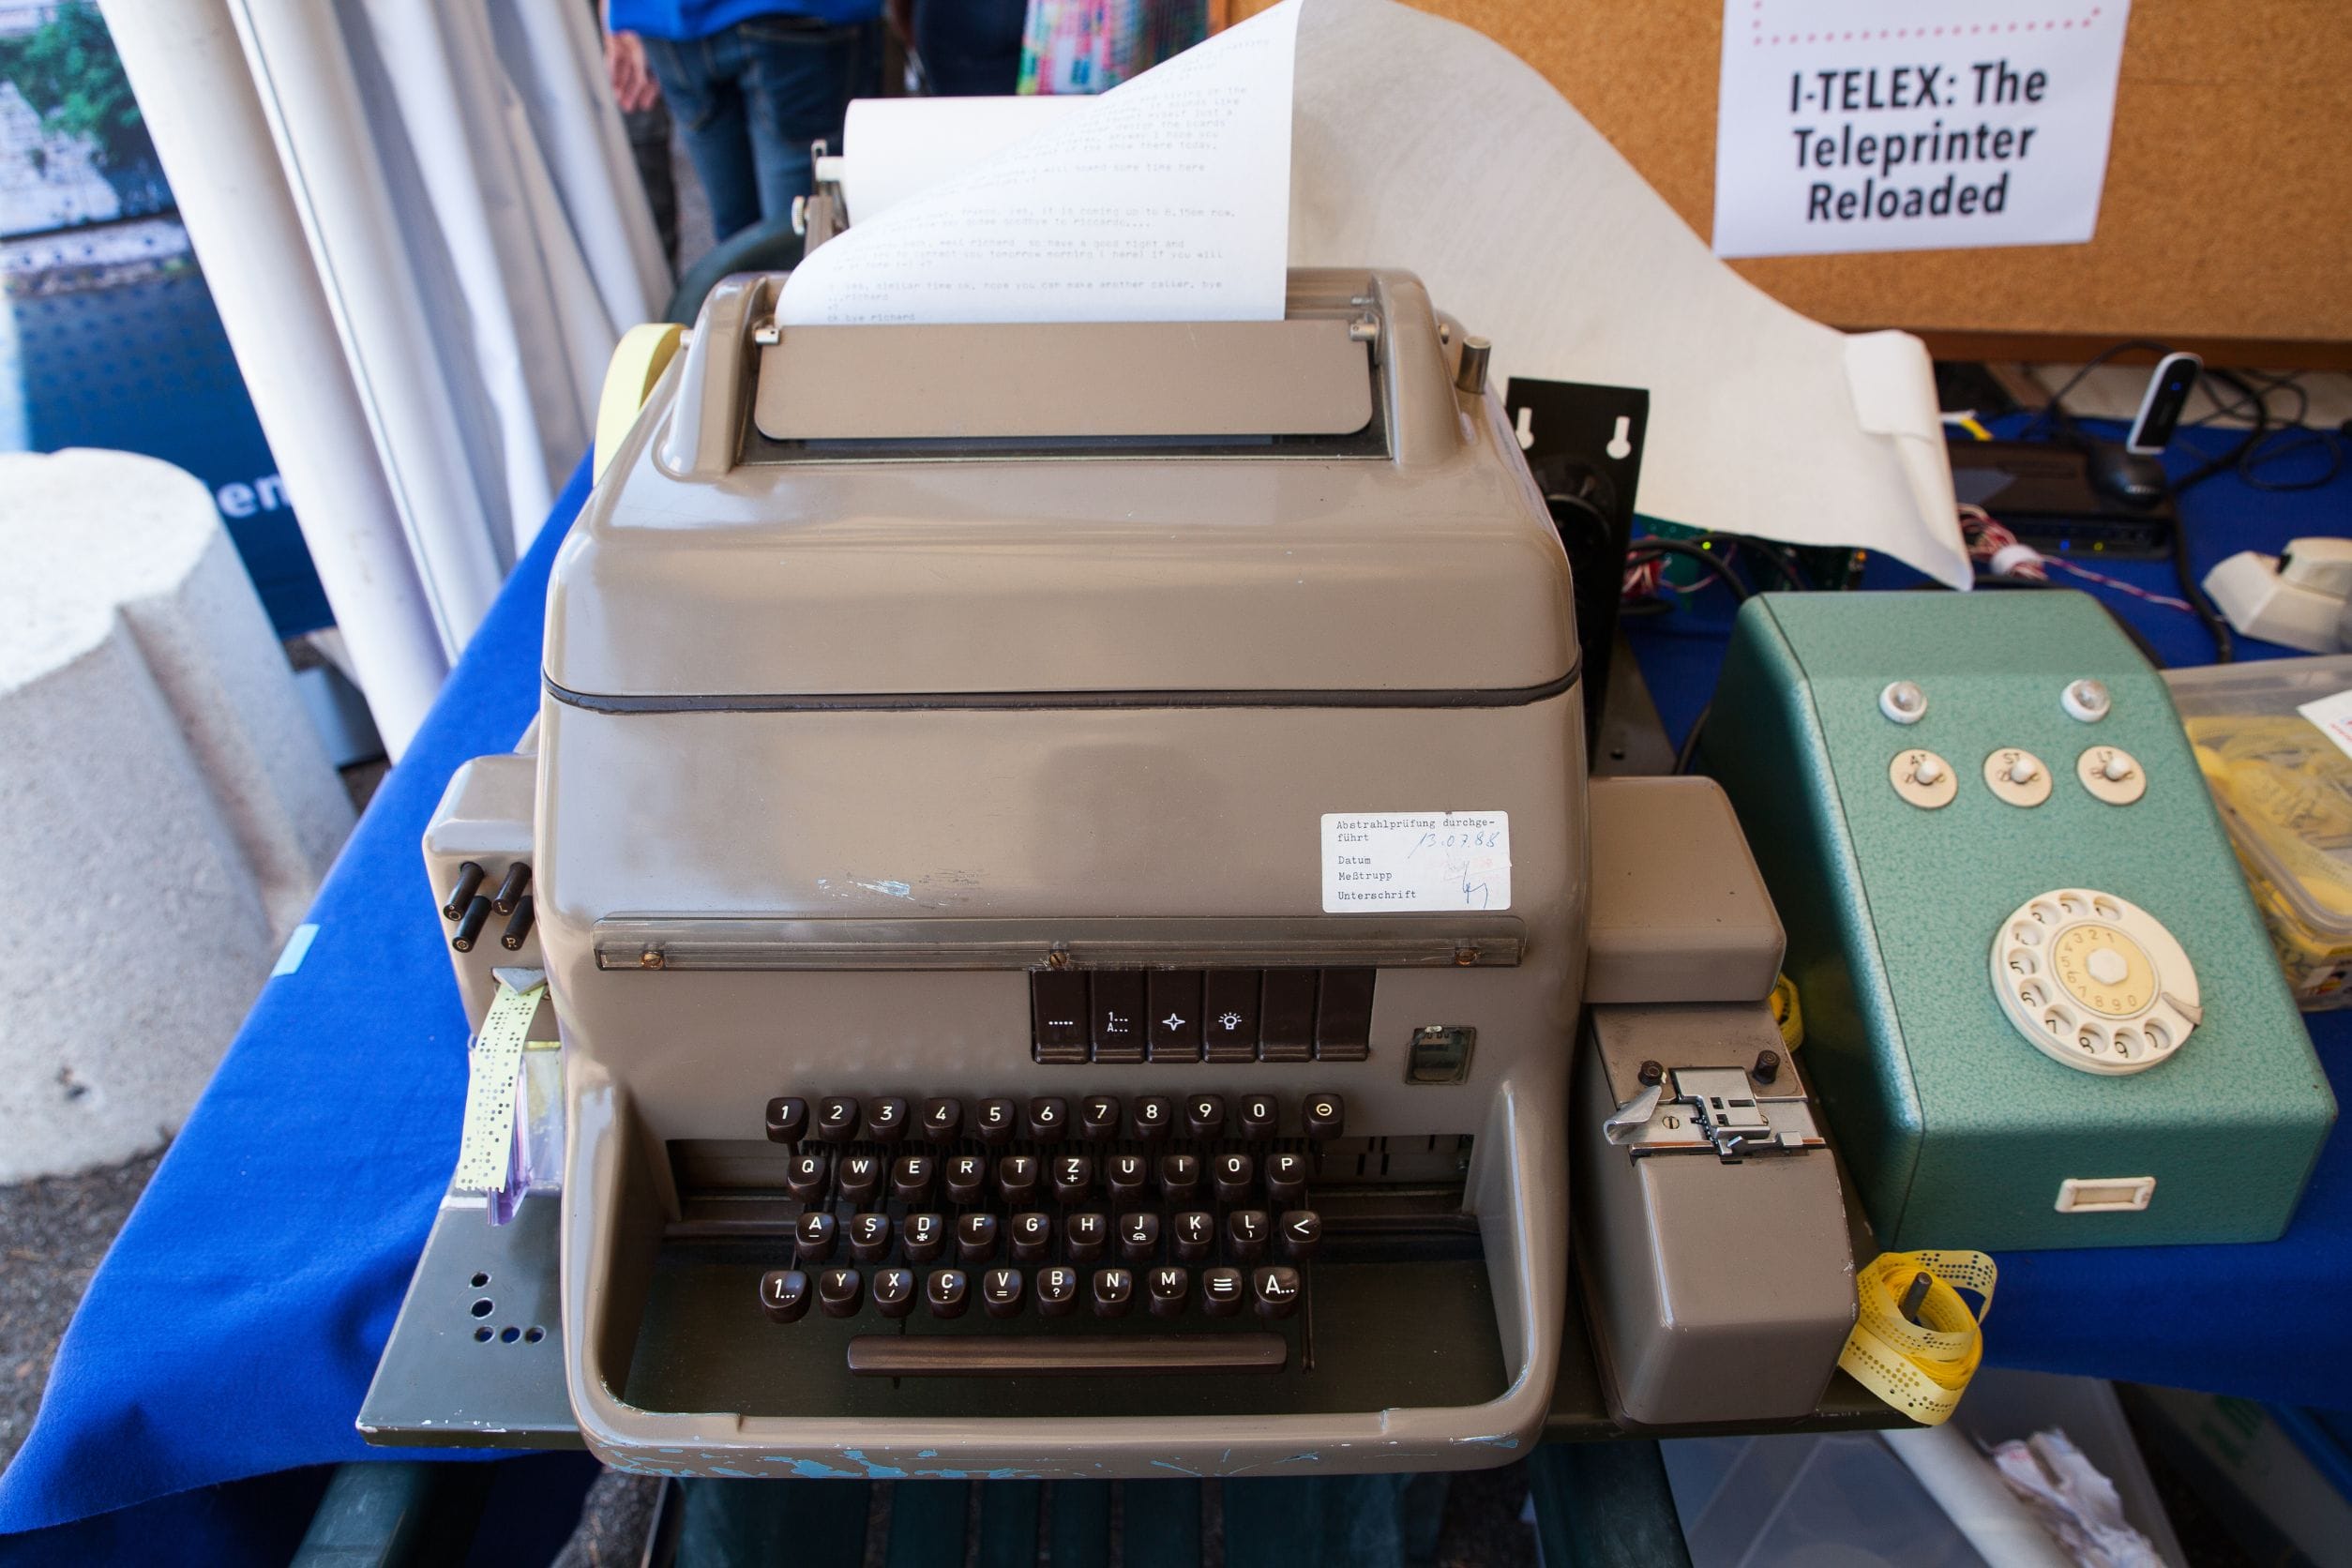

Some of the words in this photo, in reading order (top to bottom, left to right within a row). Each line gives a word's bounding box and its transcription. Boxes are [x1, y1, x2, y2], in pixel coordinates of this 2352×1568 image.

[1789, 63, 1957, 113] I-TELEX:
[1971, 58, 2049, 105] The
[1792, 120, 2037, 177] Teleprinter
[1806, 172, 2011, 222] Reloaded
[870, 312, 916, 322] richard
[1336, 819, 1436, 830] Abstrahlprüfung
[1442, 818, 1496, 827] durchge-
[1337, 833, 1369, 842] führt
[1338, 855, 1372, 865] Datum
[1338, 871, 1393, 882] Meßtrupp
[1337, 890, 1417, 900] Unterschrift
[781, 1106, 789, 1120] 1
[831, 1106, 843, 1120] 2
[880, 1106, 893, 1120] 3
[936, 1106, 946, 1120] 4
[989, 1107, 1001, 1122] 5
[1041, 1107, 1053, 1121] 6
[1094, 1105, 1108, 1119] 7
[1146, 1105, 1157, 1119] 8
[1199, 1104, 1212, 1117] 9
[802, 1160, 814, 1173] Q
[852, 1160, 868, 1173] W
[909, 1161, 921, 1173] E
[961, 1161, 972, 1173] R
[1016, 1160, 1025, 1173] T
[1067, 1159, 1079, 1172] Z
[1123, 1160, 1135, 1172] U
[1229, 1158, 1240, 1171] O
[1282, 1157, 1292, 1170] P
[809, 1217, 822, 1229] A
[865, 1218, 876, 1231] S
[918, 1218, 929, 1230] D
[972, 1218, 984, 1230] F
[1026, 1218, 1037, 1231] G
[1081, 1218, 1093, 1230] H
[1135, 1216, 1143, 1229] J
[1190, 1216, 1200, 1229] K
[1245, 1215, 1255, 1228] L
[836, 1274, 846, 1287] Y
[889, 1274, 899, 1287] X
[942, 1274, 954, 1289] C
[997, 1273, 1008, 1287] V
[1051, 1272, 1063, 1285] B
[1107, 1274, 1119, 1287] N
[1162, 1273, 1176, 1285] M
